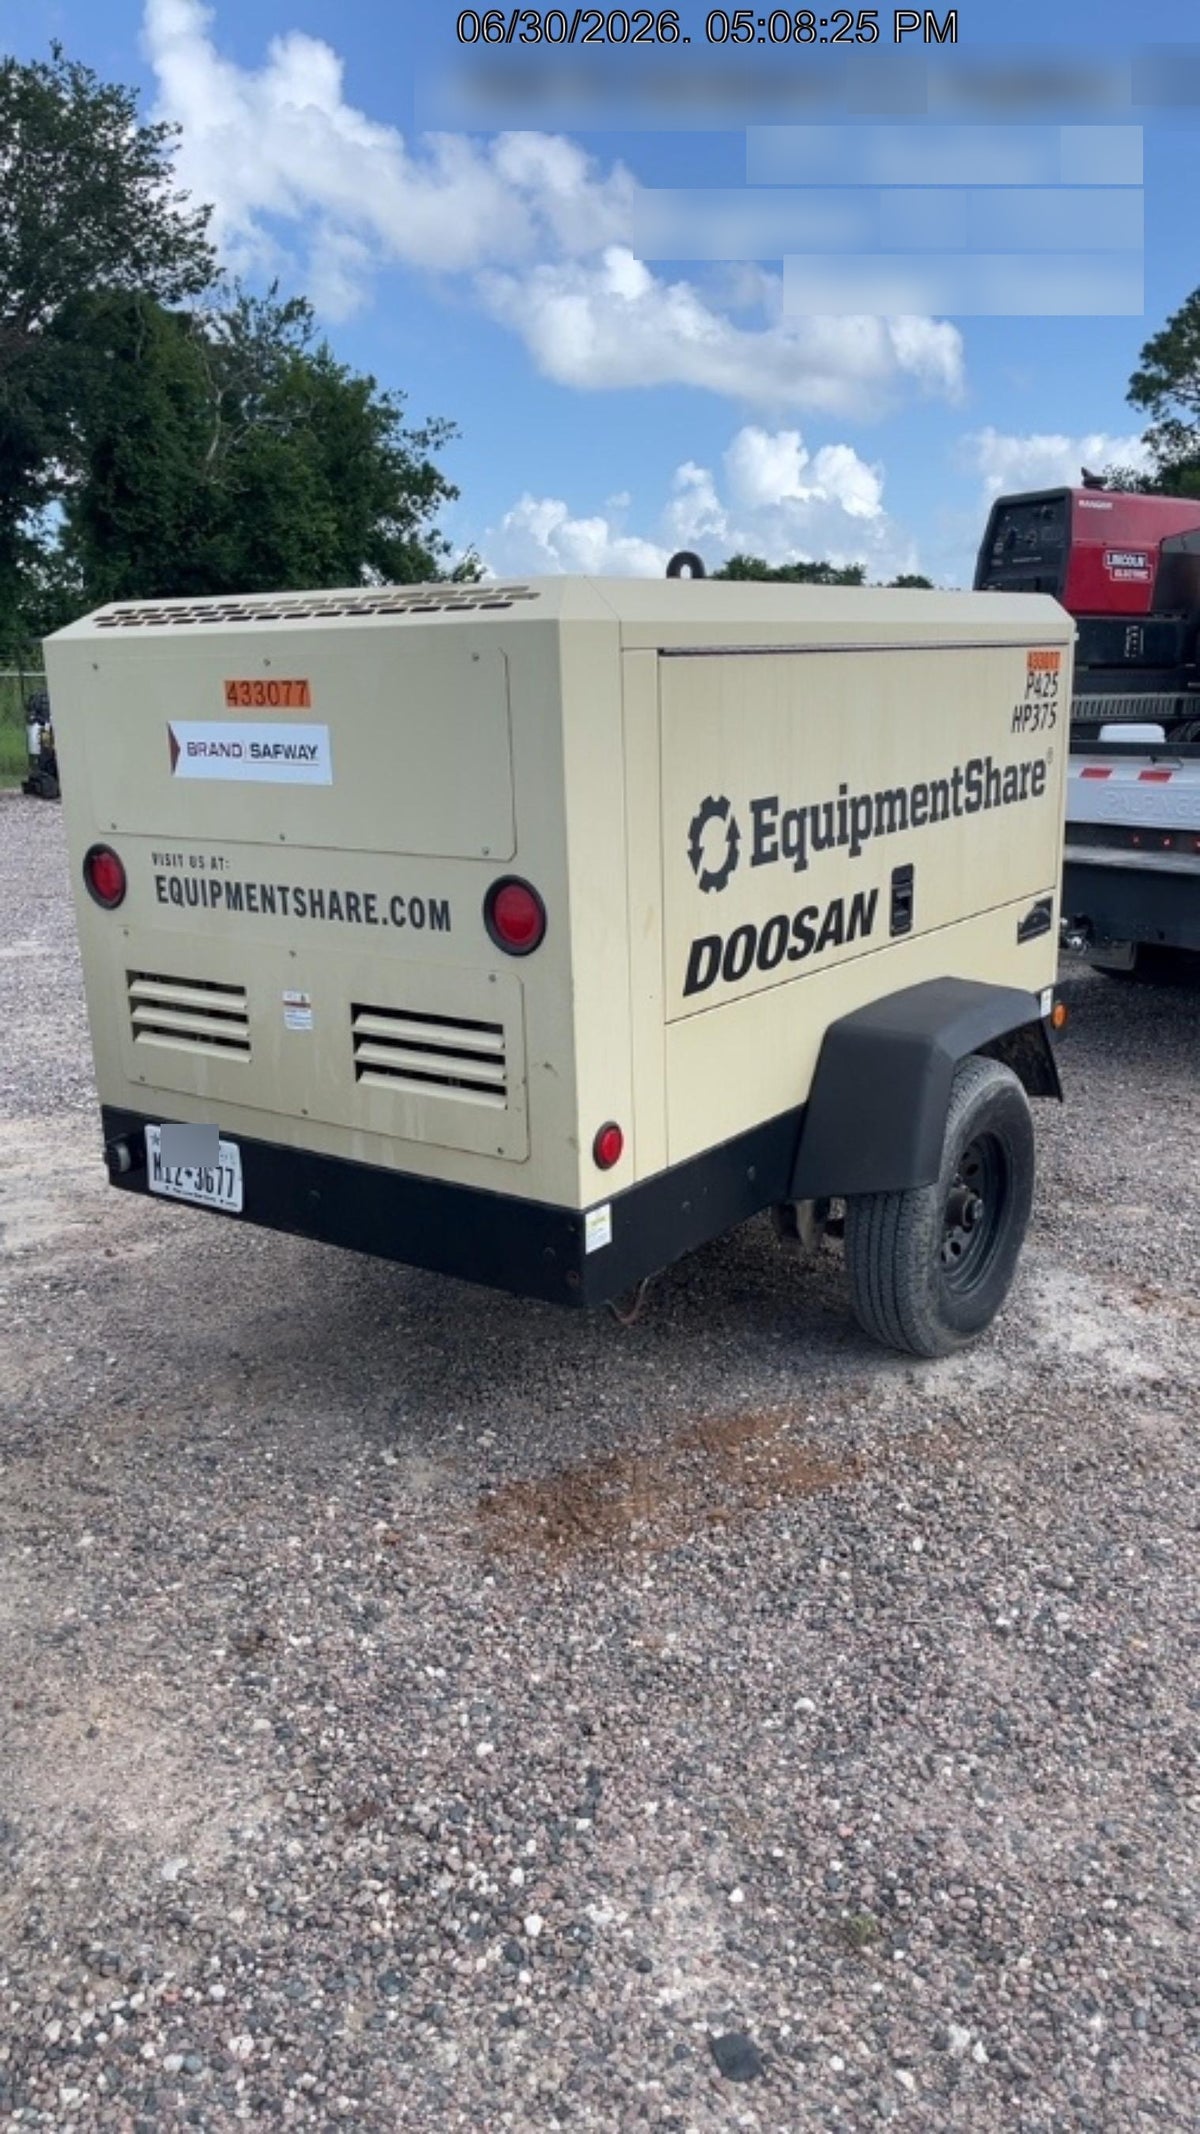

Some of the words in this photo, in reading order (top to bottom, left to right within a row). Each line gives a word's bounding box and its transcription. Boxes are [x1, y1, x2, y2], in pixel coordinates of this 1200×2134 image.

[1106, 553, 1147, 568] LINCOLN
[227, 680, 307, 706] 433077
[1024, 671, 1059, 700] P425
[1011, 702, 1058, 733] HP375
[186, 741, 243, 757] BRAND
[250, 744, 319, 760] SAFWAY
[749, 756, 1046, 873] EquipmentShare
[152, 852, 184, 868] VISIT
[189, 855, 205, 870] US
[210, 856, 230, 871] AT:
[154, 875, 452, 932] EQUIPMENTSHARE.COM
[683, 888, 879, 996] DOOSAN
